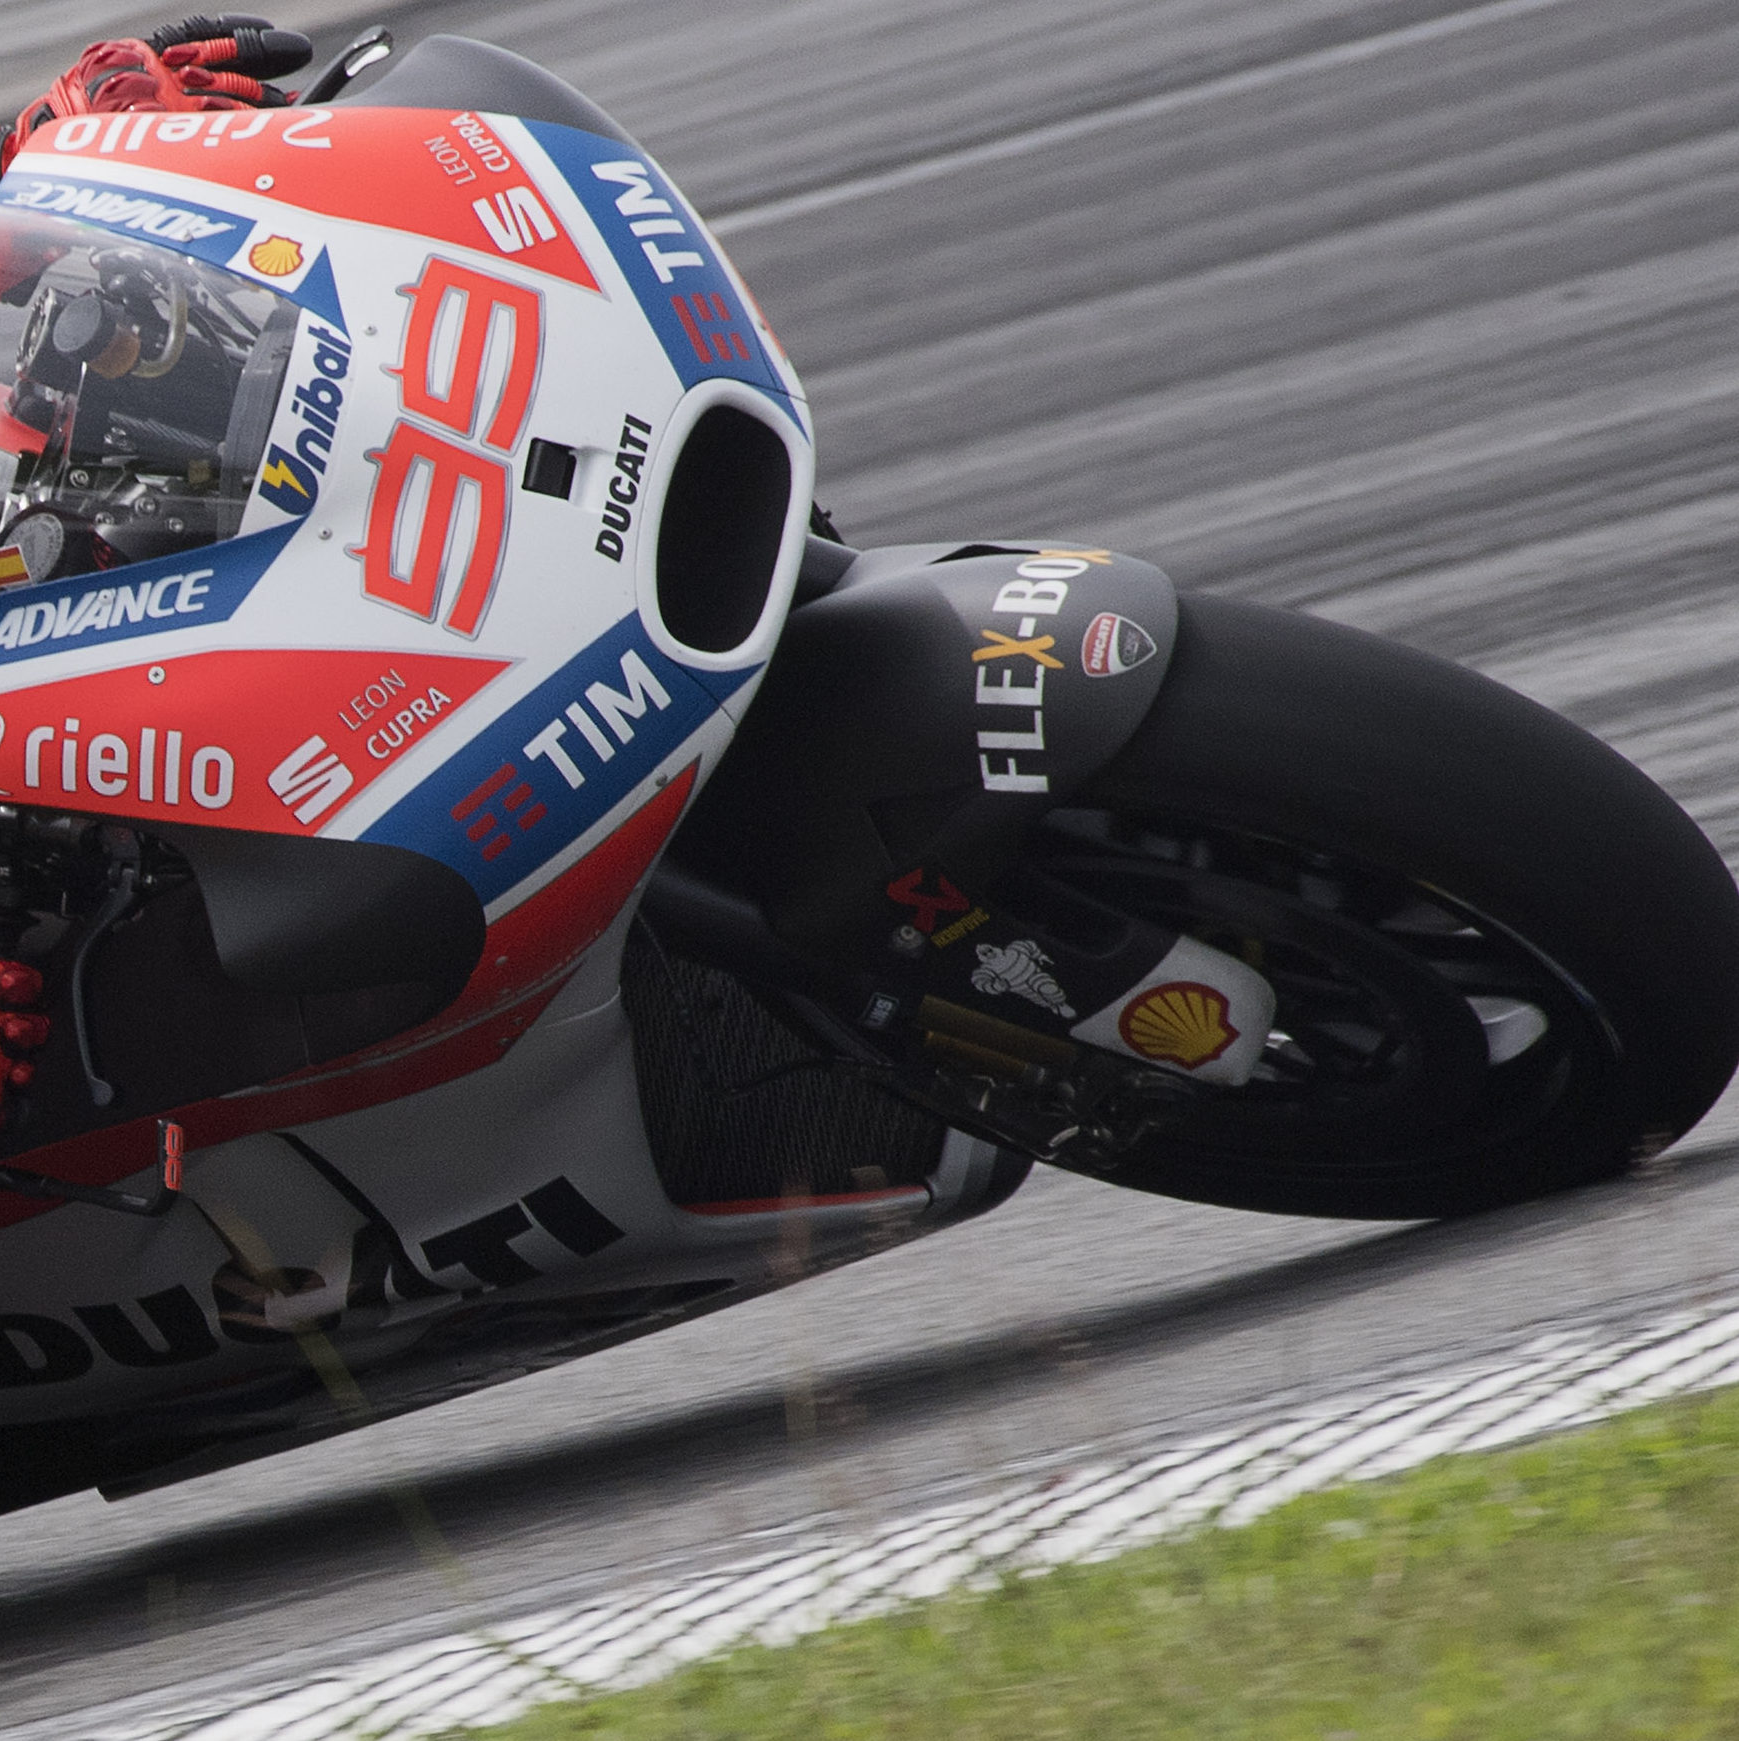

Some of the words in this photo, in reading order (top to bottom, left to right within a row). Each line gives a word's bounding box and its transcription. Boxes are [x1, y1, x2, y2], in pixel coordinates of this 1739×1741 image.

[424, 136, 477, 185] LEON
[450, 112, 511, 173] CUPRA
[590, 161, 705, 283] TIM
[258, 325, 352, 517] Unibat
[347, 256, 545, 639] 99
[595, 413, 653, 563] DUCATI
[971, 549, 1113, 793] FLEX-BOX
[1091, 618, 1112, 670] DUCATI
[338, 668, 406, 731] LEON
[366, 686, 452, 759] CUPRA
[522, 648, 672, 790] TIM
[24, 717, 234, 810] riello
